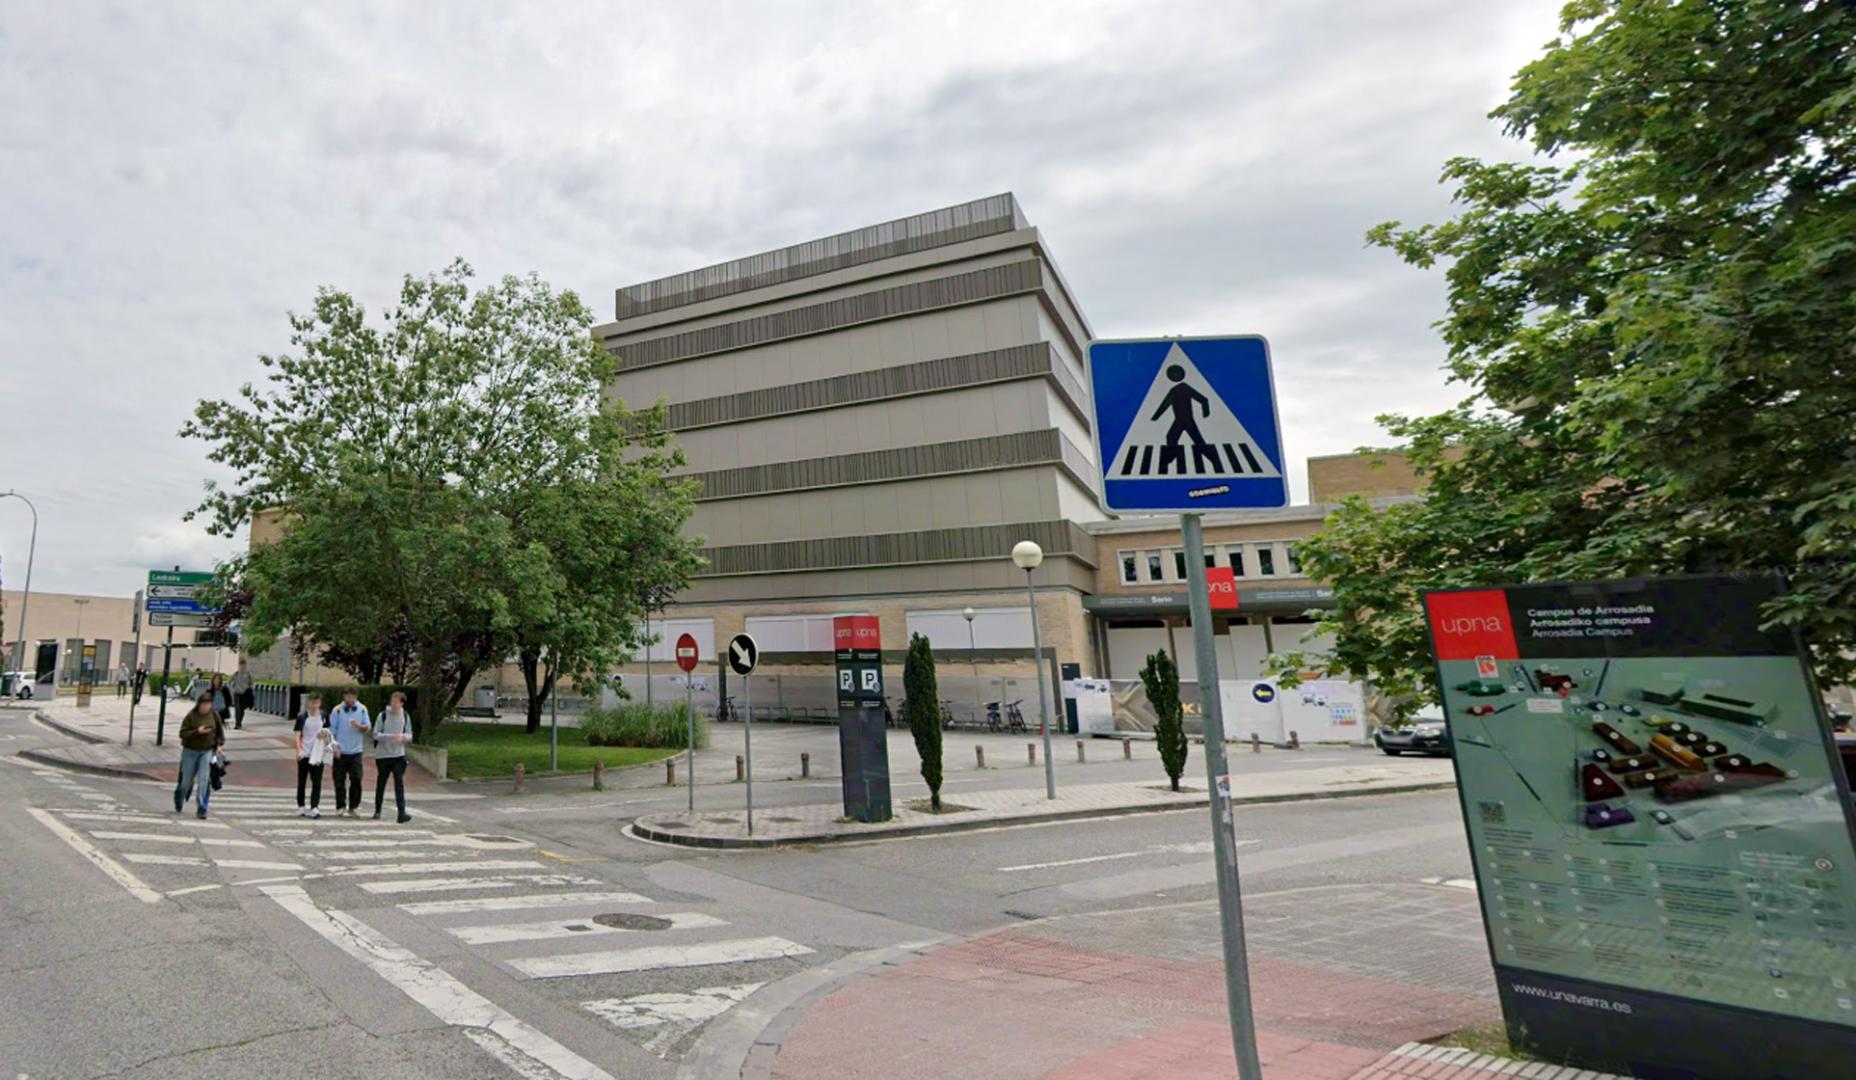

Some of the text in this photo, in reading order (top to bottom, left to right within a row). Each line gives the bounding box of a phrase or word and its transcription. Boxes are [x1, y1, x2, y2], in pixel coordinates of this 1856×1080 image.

[1527, 604, 1654, 618] Campus de Arrosadia
[1440, 616, 1503, 637] upna
[1530, 616, 1651, 628] Arrosadiko campusa
[1532, 627, 1634, 638] Arrosadia Campus
[865, 672, 874, 686] P
[1511, 983, 1633, 1015] www.unavarra.es
